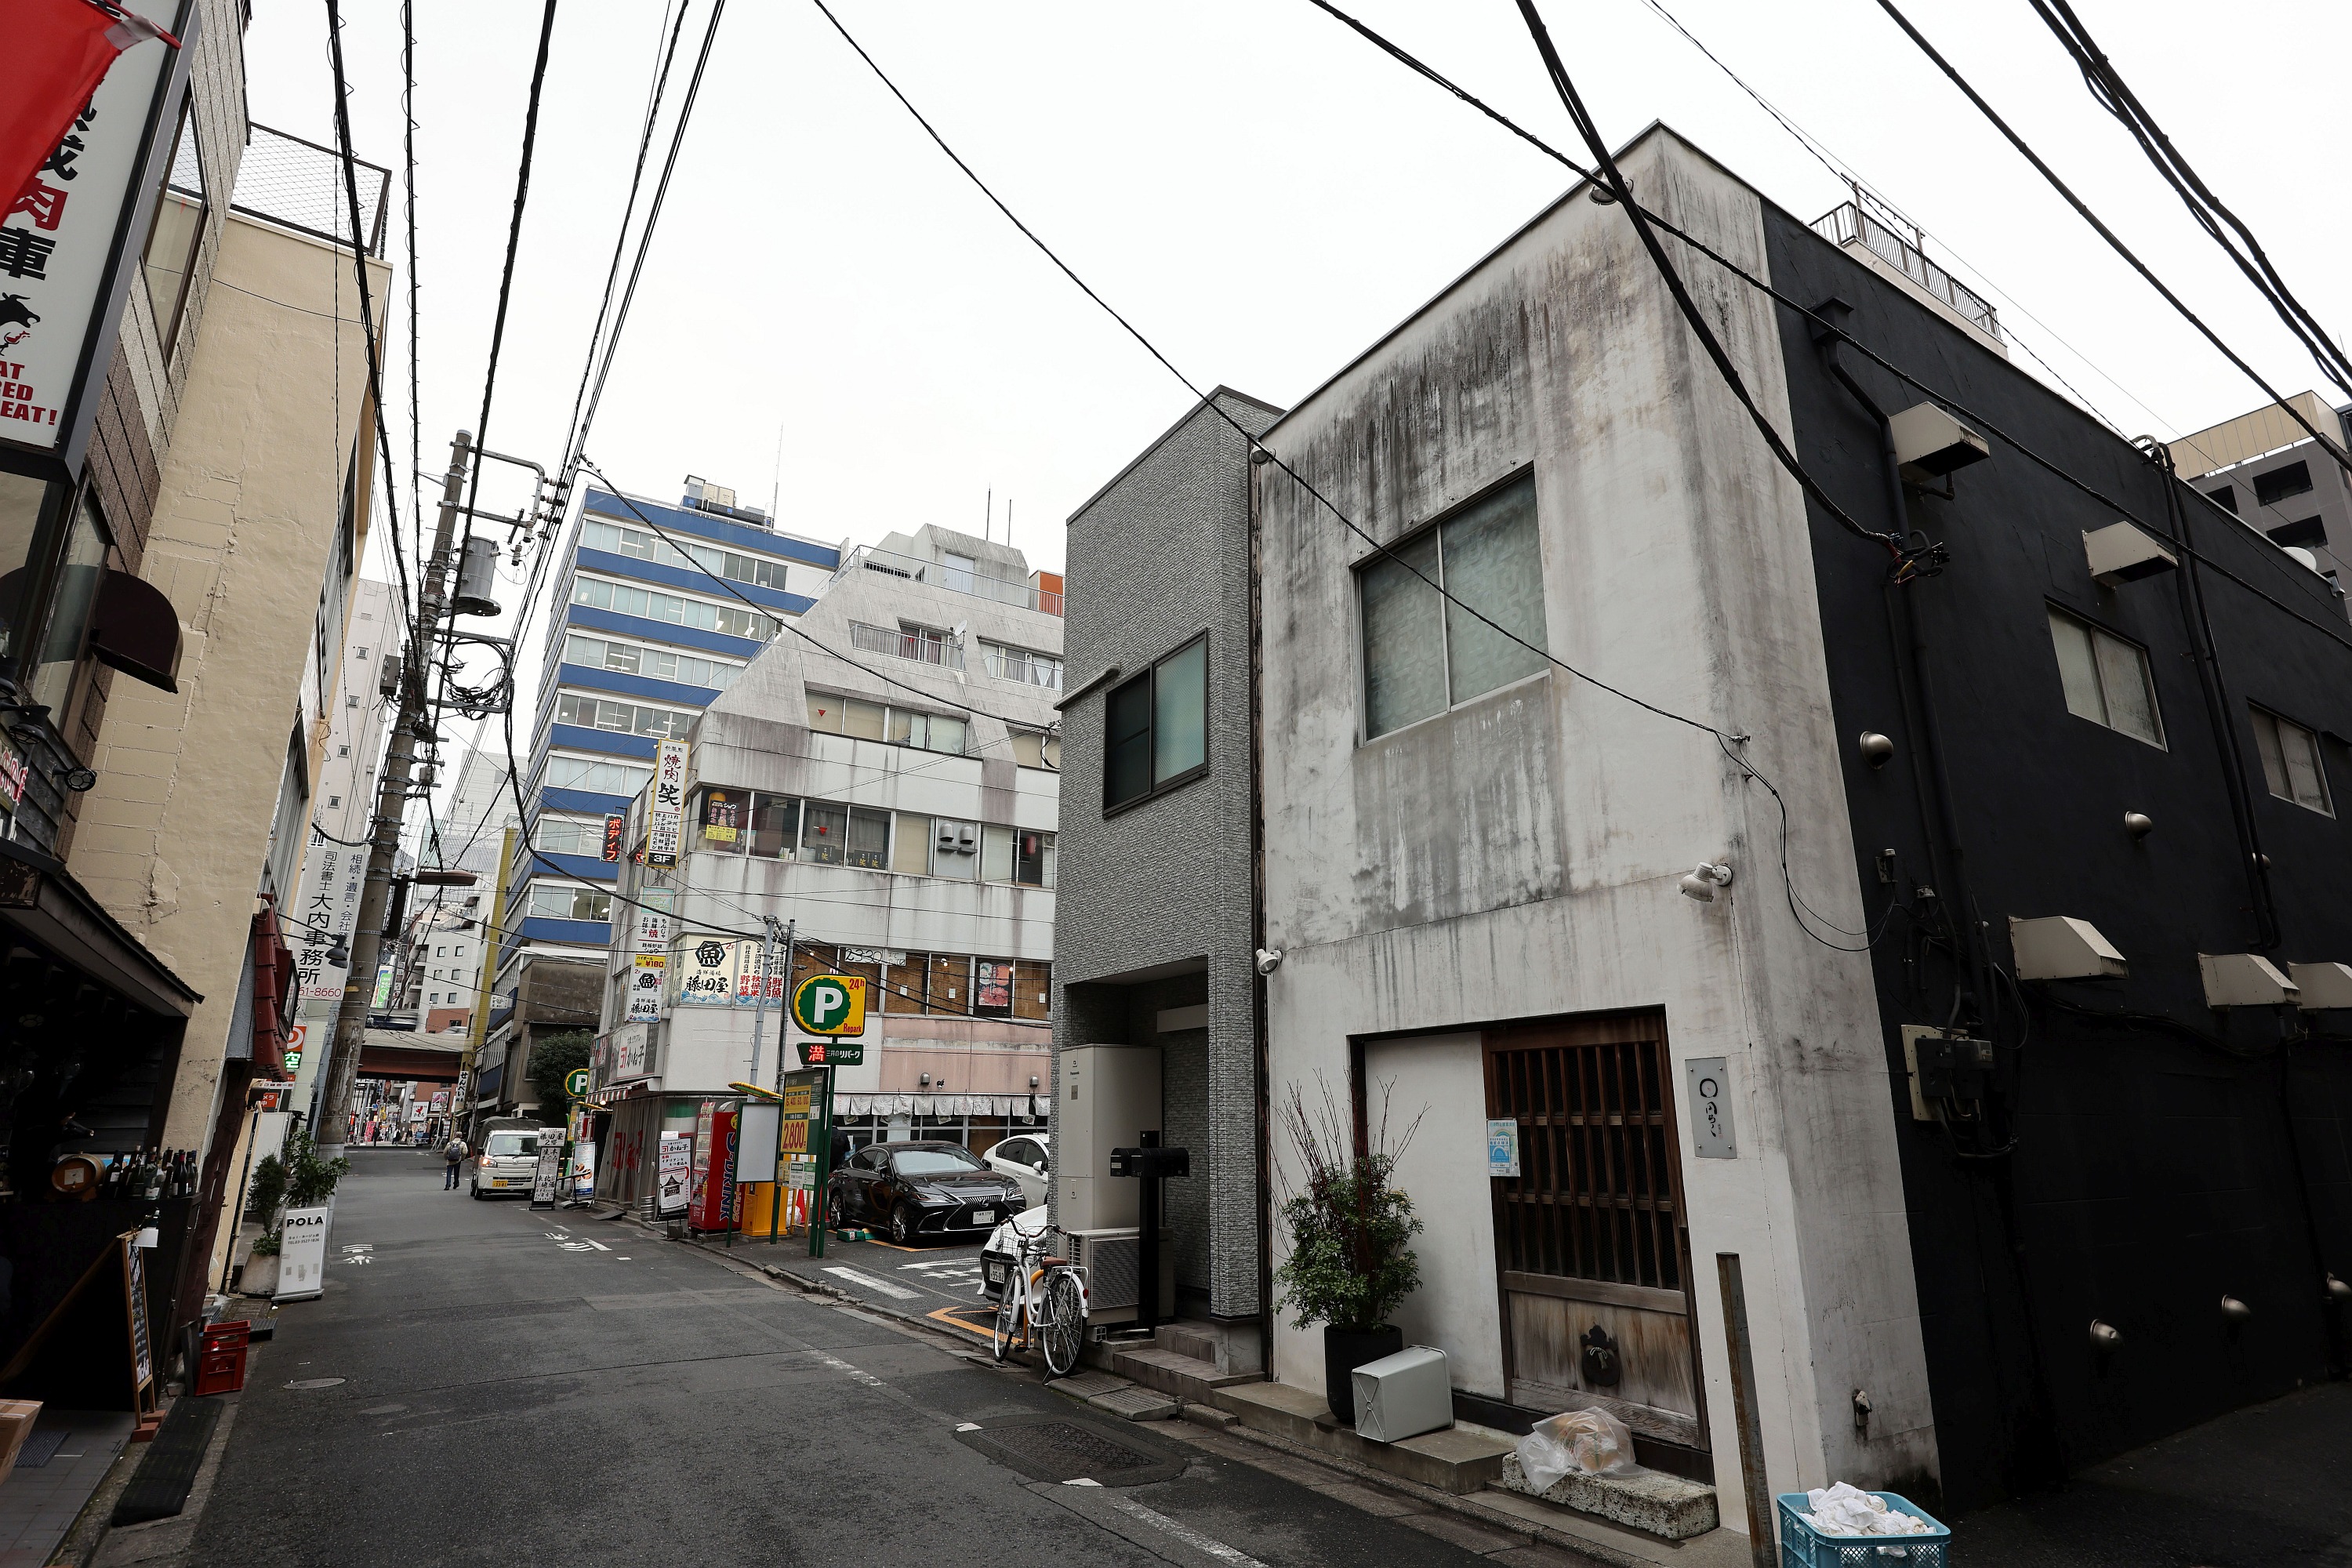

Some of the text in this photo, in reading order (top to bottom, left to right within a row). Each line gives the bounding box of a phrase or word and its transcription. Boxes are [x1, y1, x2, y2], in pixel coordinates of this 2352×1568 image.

[0, 382, 34, 401] ED
[659, 754, 681, 806] 焼肉 笑
[653, 855, 671, 863] 3F
[298, 851, 338, 985] 司法書士 大内事務所
[645, 960, 664, 968] ¥180
[684, 975, 729, 993] 藤田屋
[739, 975, 750, 996] 野菜
[771, 977, 783, 998] 鮮魚
[849, 978, 865, 989] 24h
[630, 1004, 659, 1014] 藤田屋
[814, 986, 844, 1023] P
[843, 1023, 862, 1033] Repark
[285, 1051, 301, 1069] 空
[626, 1044, 644, 1069] かね子
[808, 1045, 825, 1062] 満
[826, 1051, 861, 1059] 三井のリパーク
[457, 1072, 469, 1097] せんべい
[575, 1074, 589, 1093] P
[286, 1216, 324, 1228] POLA
